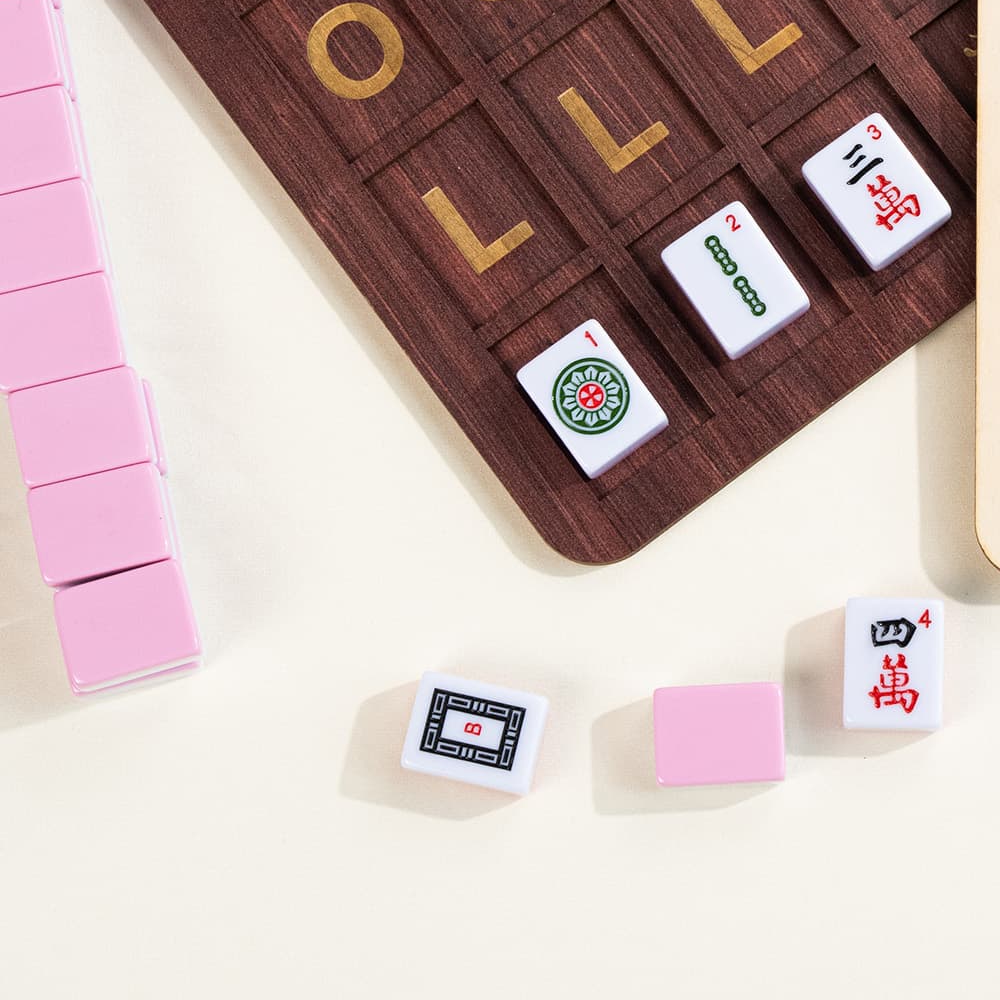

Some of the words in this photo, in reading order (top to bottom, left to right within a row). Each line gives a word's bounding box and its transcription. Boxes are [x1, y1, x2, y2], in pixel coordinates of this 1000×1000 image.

[306, 1, 405, 100] O
[867, 124, 882, 141] 3
[421, 186, 534, 274] L
[558, 87, 670, 174] L
[725, 214, 741, 232] 2
[584, 331, 598, 347] 1
[918, 609, 932, 629] 4
[463, 722, 482, 736] B
